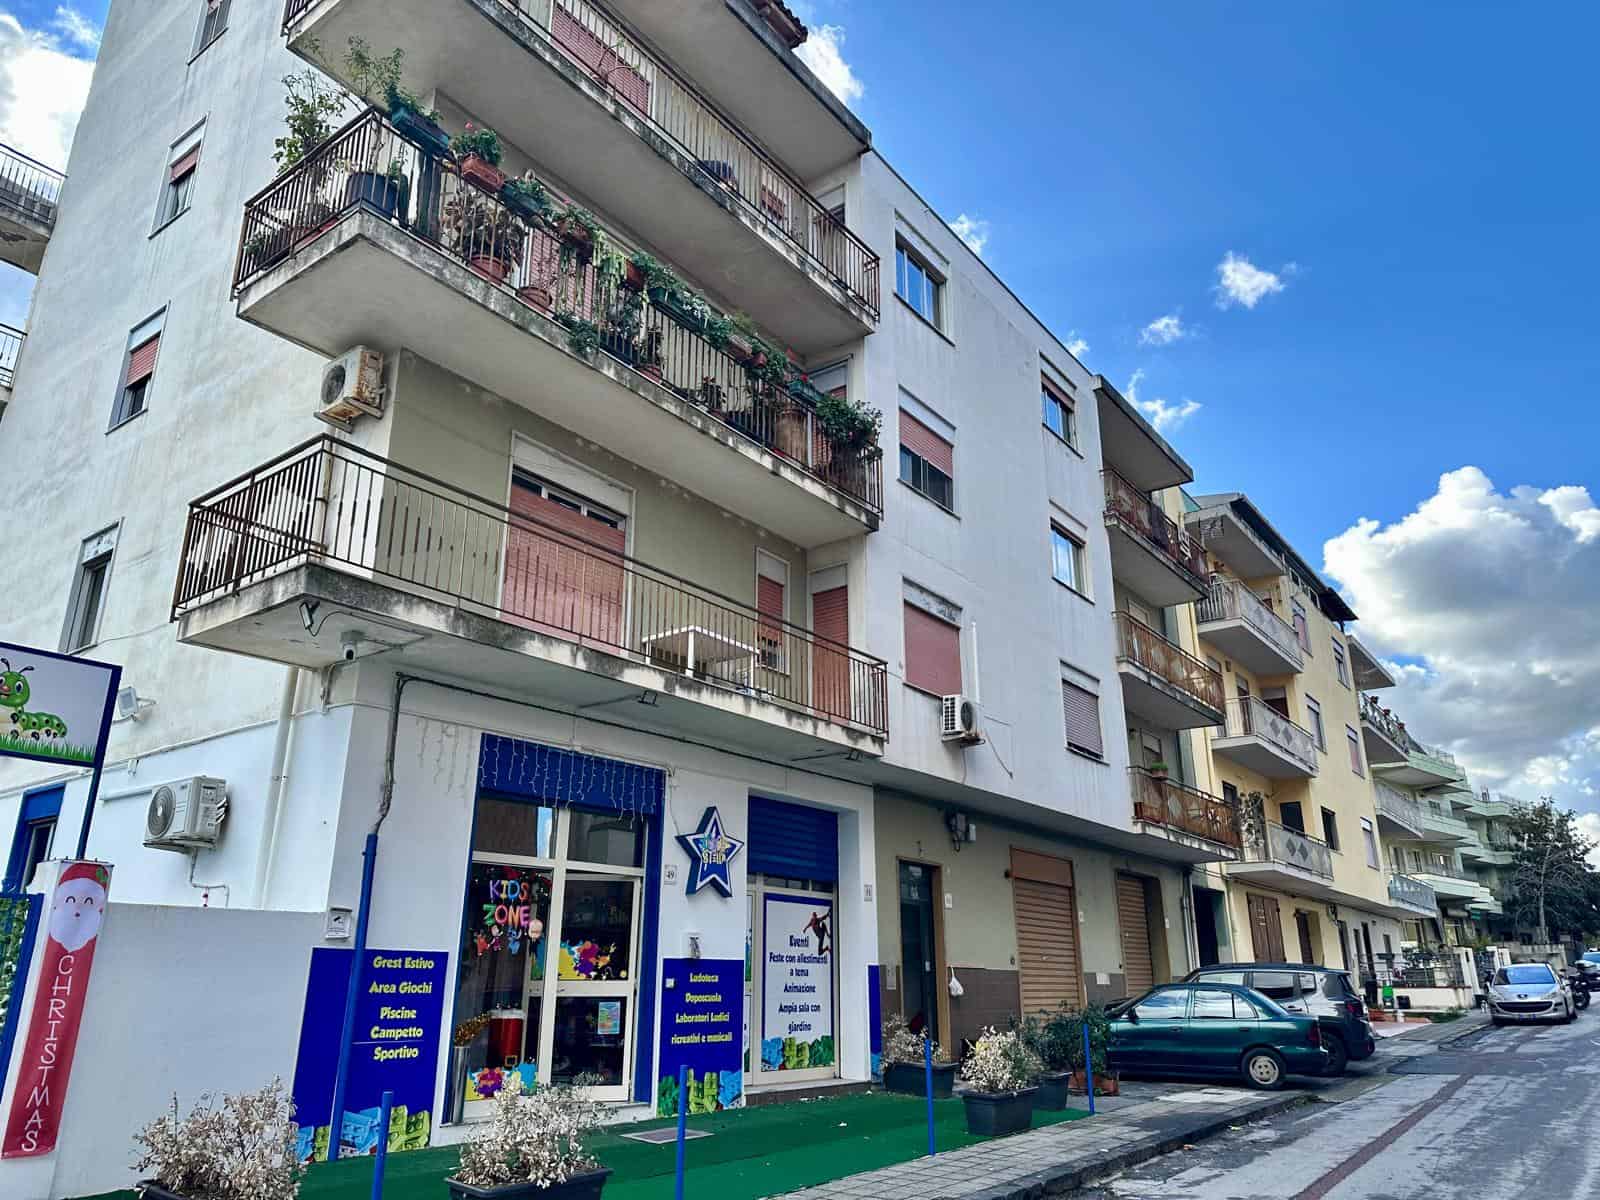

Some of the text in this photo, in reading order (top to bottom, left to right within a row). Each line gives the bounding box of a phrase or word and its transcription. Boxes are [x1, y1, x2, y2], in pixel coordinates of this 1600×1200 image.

[489, 879, 529, 900] KIDS
[483, 903, 530, 927] ZONE
[789, 935, 809, 948] Eventi
[373, 956, 435, 969] Grest Estivo
[769, 952, 785, 963] Feste
[785, 954, 796, 963] con
[795, 967, 809, 977] tema
[369, 980, 433, 994] Area Giochi
[783, 982, 816, 993] Animazione
[380, 1006, 417, 1019] Piscine
[778, 1002, 821, 1015] Ampia sala con
[370, 1026, 424, 1040] Campetto
[788, 1021, 812, 1034] giardino
[21, 955, 74, 1152] CHRISTMAS
[373, 1045, 419, 1062] Sportivo
